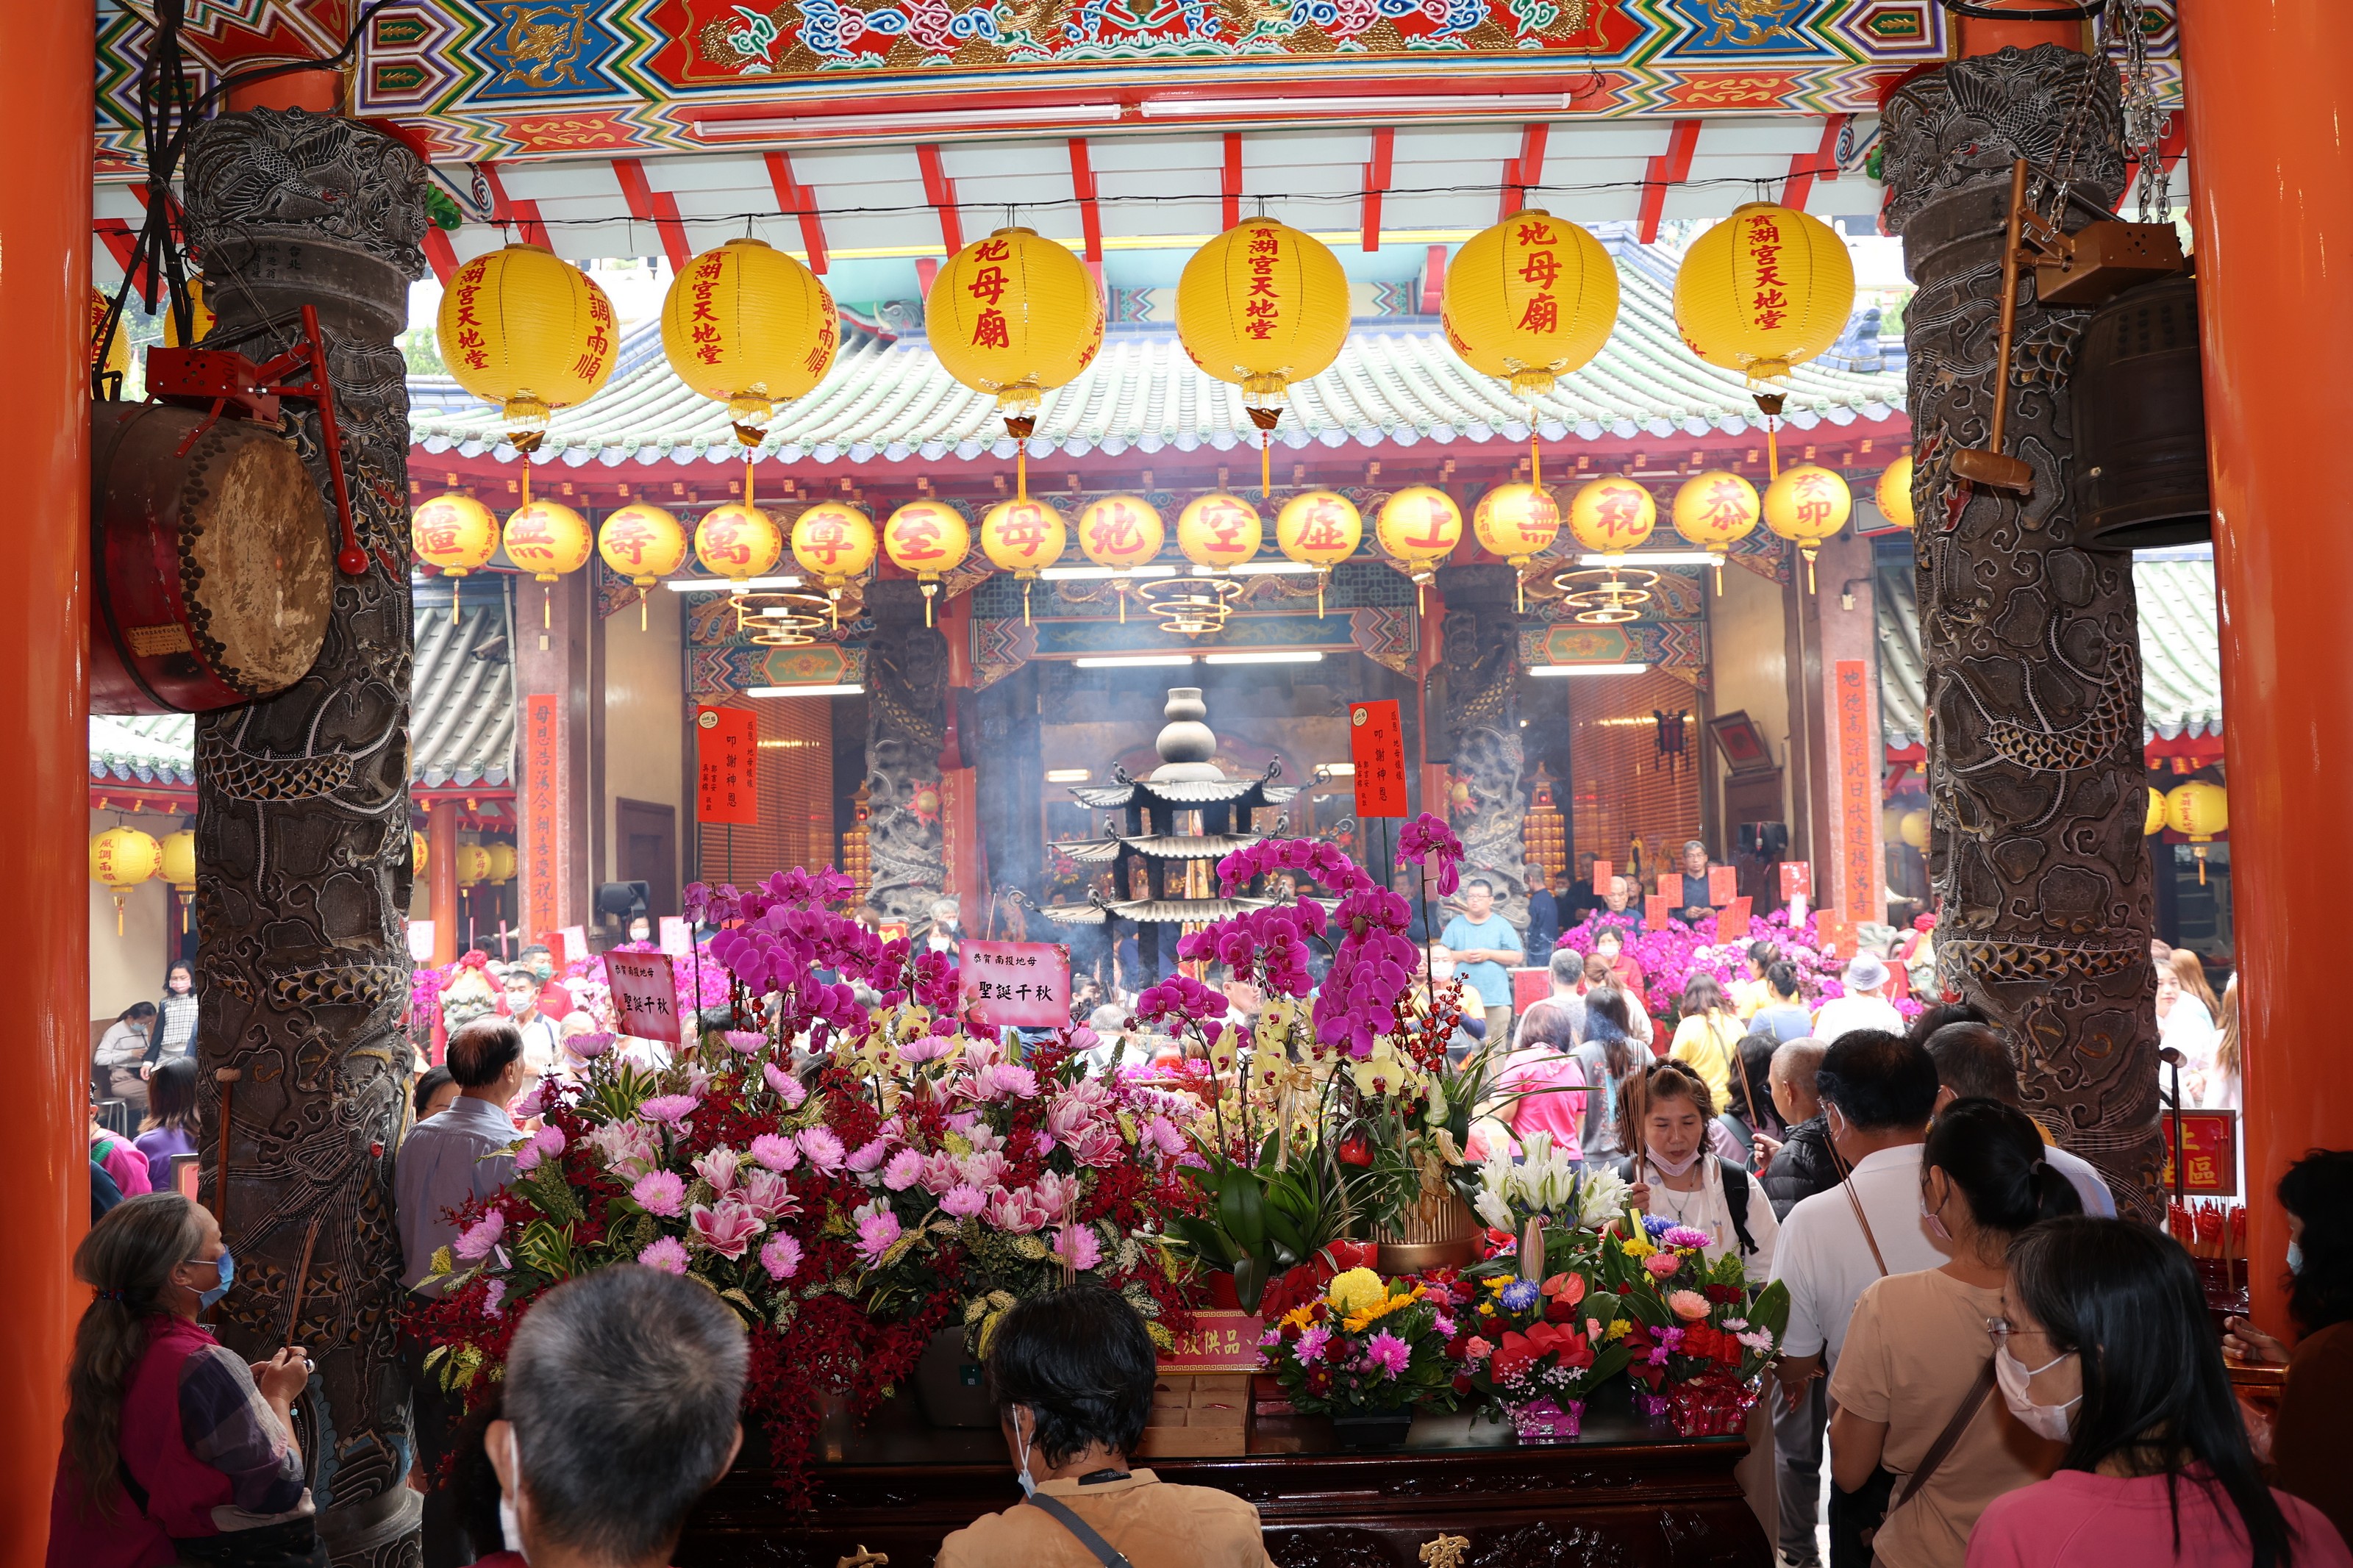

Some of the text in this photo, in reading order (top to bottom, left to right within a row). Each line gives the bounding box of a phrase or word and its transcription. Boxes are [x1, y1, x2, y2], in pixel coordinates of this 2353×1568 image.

[968, 240, 1010, 349] 地母廟
[1245, 228, 1281, 340] 寶湖宮天地堂
[1517, 221, 1563, 335] 地母廟
[572, 271, 611, 384] 風調雨順
[1199, 499, 1254, 552] 空
[1404, 496, 1455, 548] 上
[1517, 490, 1560, 544] 無
[1596, 487, 1649, 538] 祝
[1698, 479, 1752, 531] 恭
[1793, 473, 1834, 527] 癸卯
[506, 507, 556, 559] 無
[604, 512, 657, 565] 壽
[701, 512, 751, 565] 萬
[800, 512, 854, 565] 尊
[892, 508, 946, 560] 至
[995, 504, 1051, 556] 母
[1089, 502, 1145, 555] 地
[726, 736, 737, 807] 叩謝神恩
[1374, 729, 1388, 801] 叩謝神恩
[99, 839, 116, 881] 風調雨順
[615, 964, 654, 978] 恭賀 南投地母
[974, 953, 1037, 967] 恭賀 南投地母
[624, 992, 670, 1016] 聖誕千秋
[979, 981, 1053, 1002] 聖誕千秋
